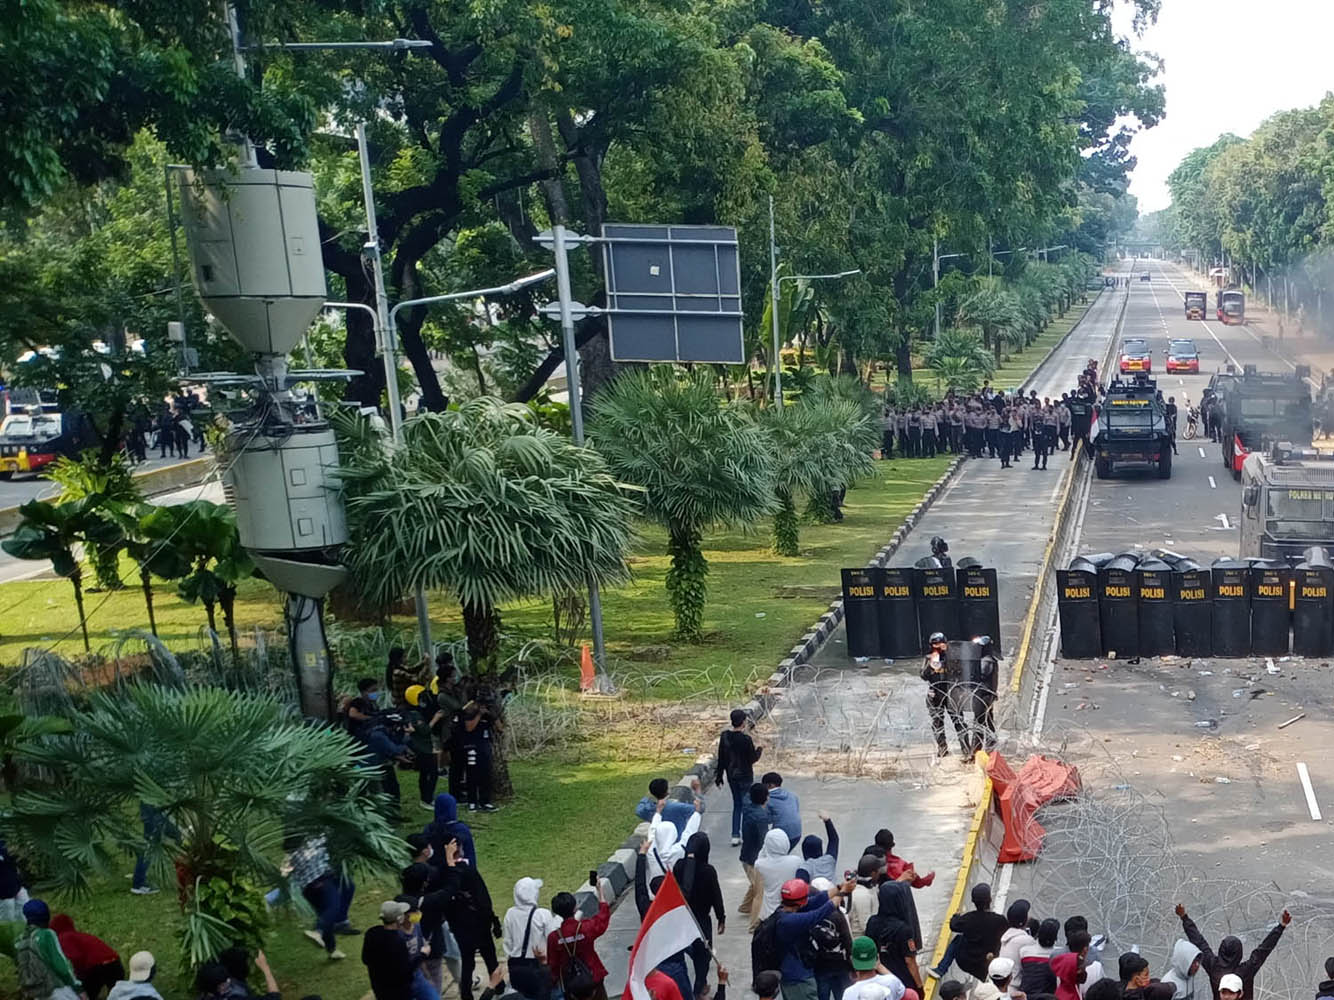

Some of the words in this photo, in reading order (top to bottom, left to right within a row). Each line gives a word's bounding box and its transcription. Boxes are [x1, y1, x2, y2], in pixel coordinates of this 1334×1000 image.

[849, 586, 874, 596] POLISI
[884, 586, 909, 596] POLISI
[924, 586, 949, 596] POLISI
[964, 586, 990, 597] POLISI
[1065, 587, 1090, 598] POLISI
[1105, 586, 1130, 597] POLISI
[1140, 588, 1165, 599] POLISI
[1180, 589, 1205, 599] POLISI
[1218, 585, 1244, 596] POLISI
[1258, 585, 1283, 597] POLISI
[1302, 587, 1327, 598] POLISI
